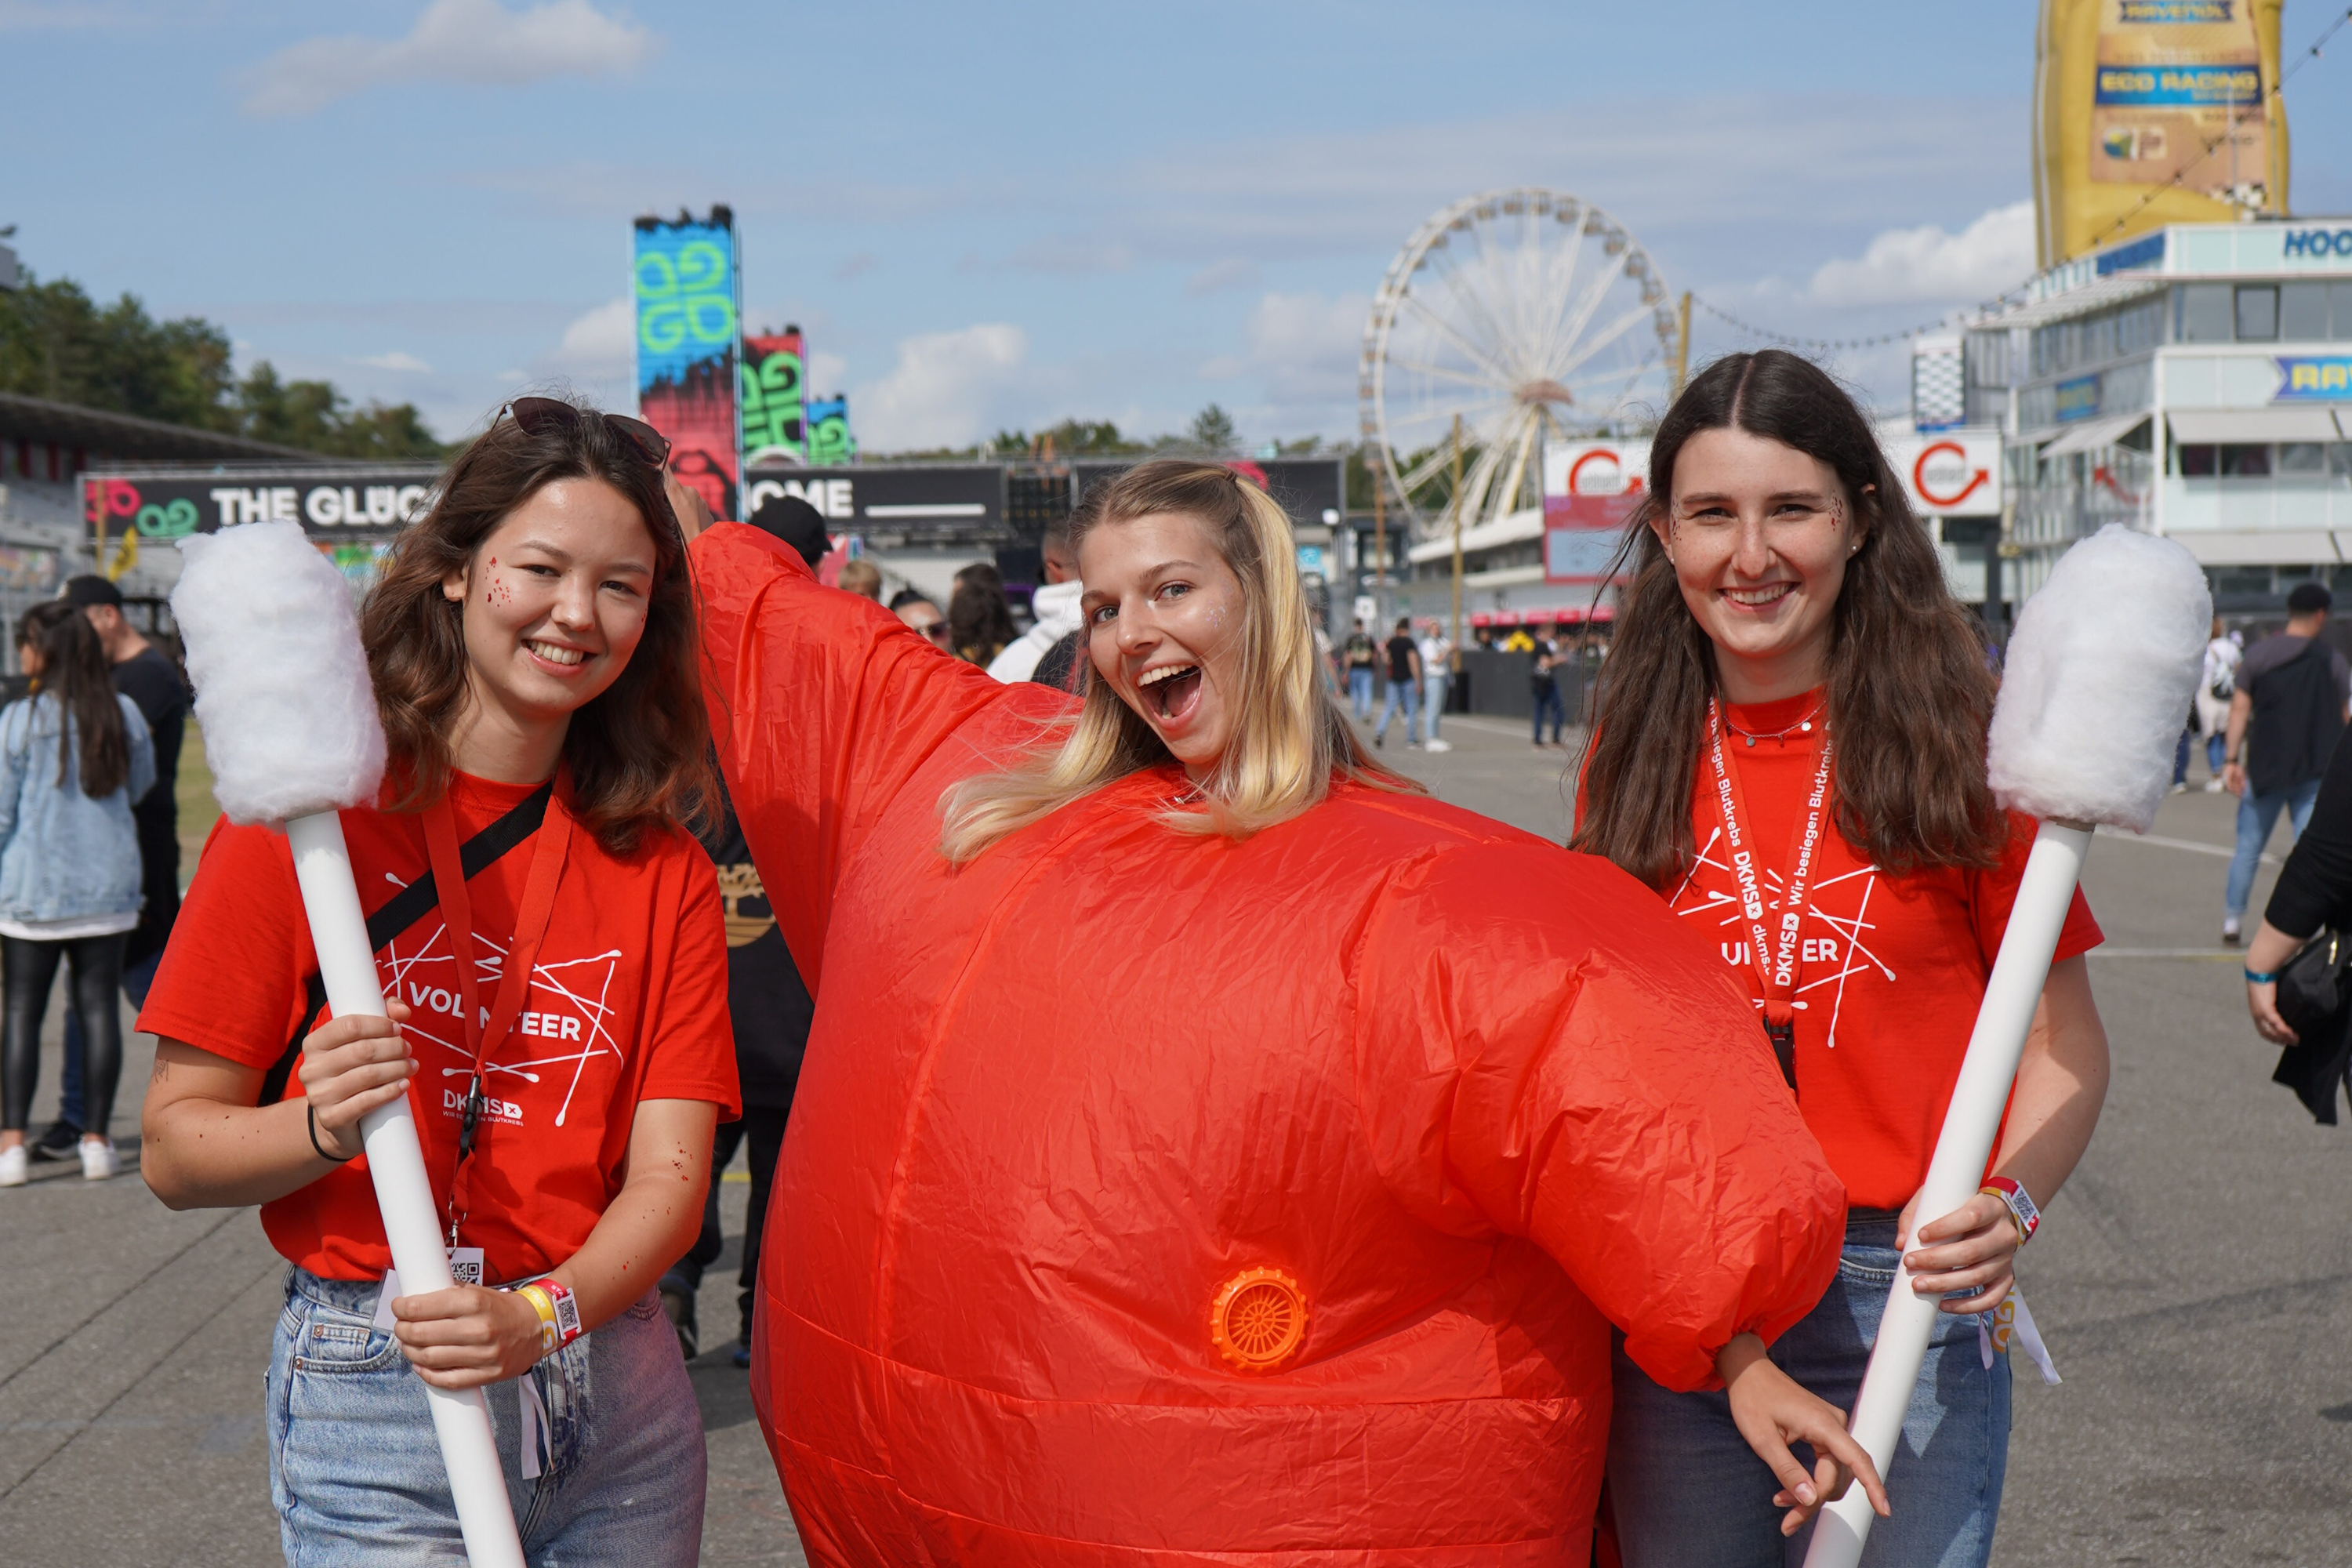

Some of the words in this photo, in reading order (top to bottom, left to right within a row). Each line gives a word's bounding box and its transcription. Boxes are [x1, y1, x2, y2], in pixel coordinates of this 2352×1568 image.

[210, 486, 299, 526] THE
[305, 485, 445, 526] GLÜC
[738, 478, 854, 518] OME
[1809, 739, 1835, 808] Blutkrebs
[1710, 717, 1726, 779] besiegen
[1718, 778, 1741, 847] Blutkrebs
[1733, 851, 1760, 904] DKMS
[1793, 811, 1820, 877] besiegen
[1788, 880, 1805, 906] Wir
[1775, 931, 1797, 986] DKMS
[408, 981, 582, 1041] VOLNEER
[488, 1116, 524, 1127] BLUTKREBS
